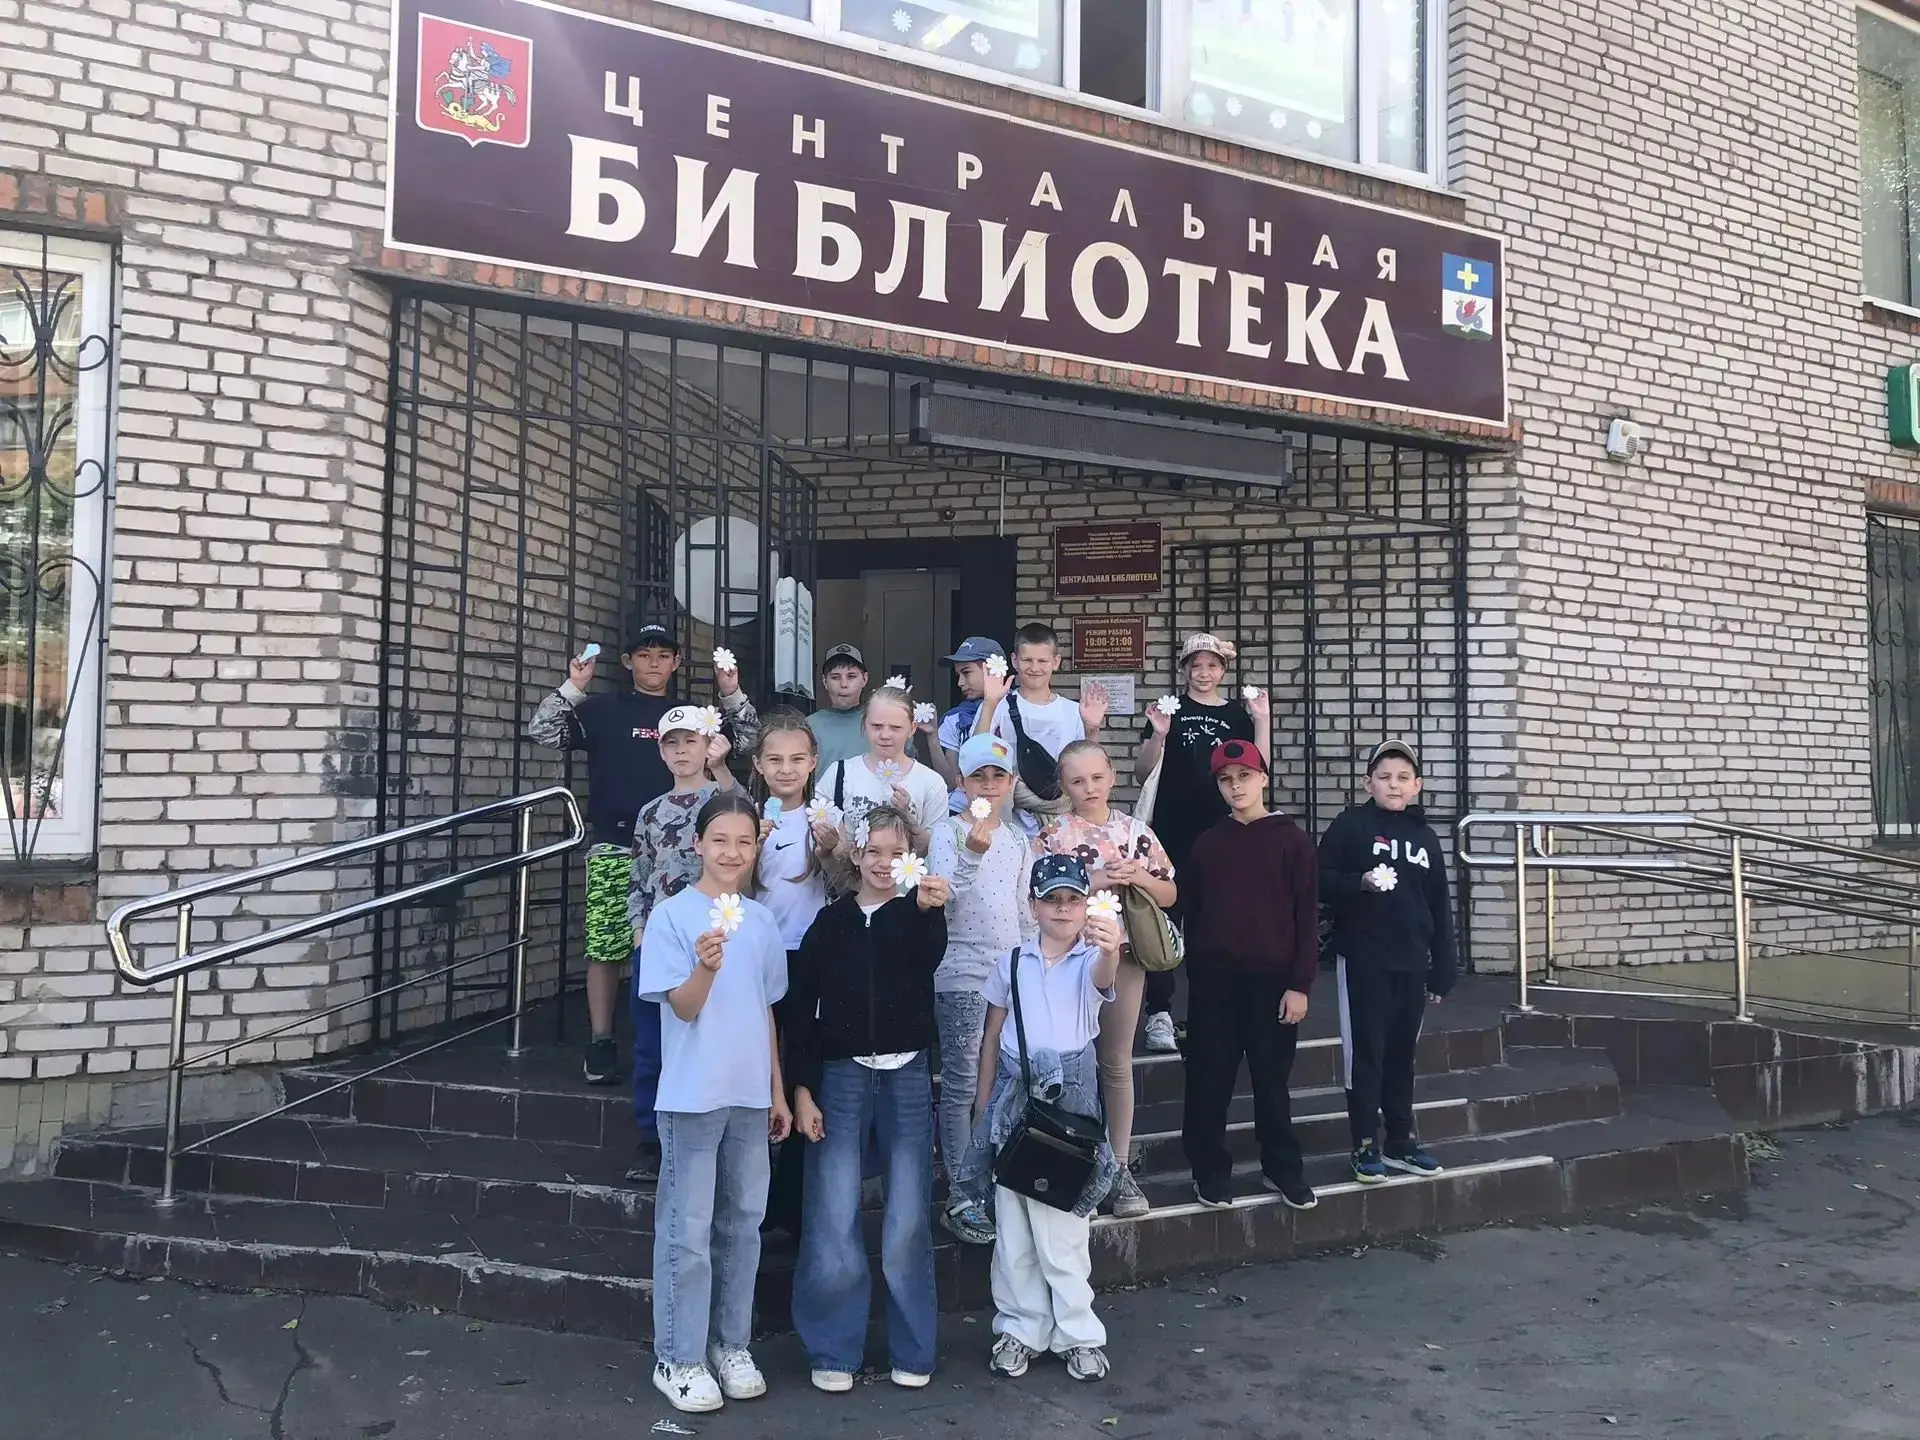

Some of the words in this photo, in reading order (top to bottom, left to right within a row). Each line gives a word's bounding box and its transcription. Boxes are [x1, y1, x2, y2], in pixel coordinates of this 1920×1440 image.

[603, 70, 1398, 282] ЦЕНТРАЛЬНАЯ
[564, 133, 1410, 382] БИБЛИОТЕКА
[1060, 574, 1110, 584] ЦЕНТРАЛЬНАЯ
[1111, 572, 1158, 583] БИБЛИОТЕКА
[1085, 636, 1133, 646] 10:00-21:00
[1108, 628, 1132, 636] РАБОТЫ
[1372, 836, 1430, 869] FILA
